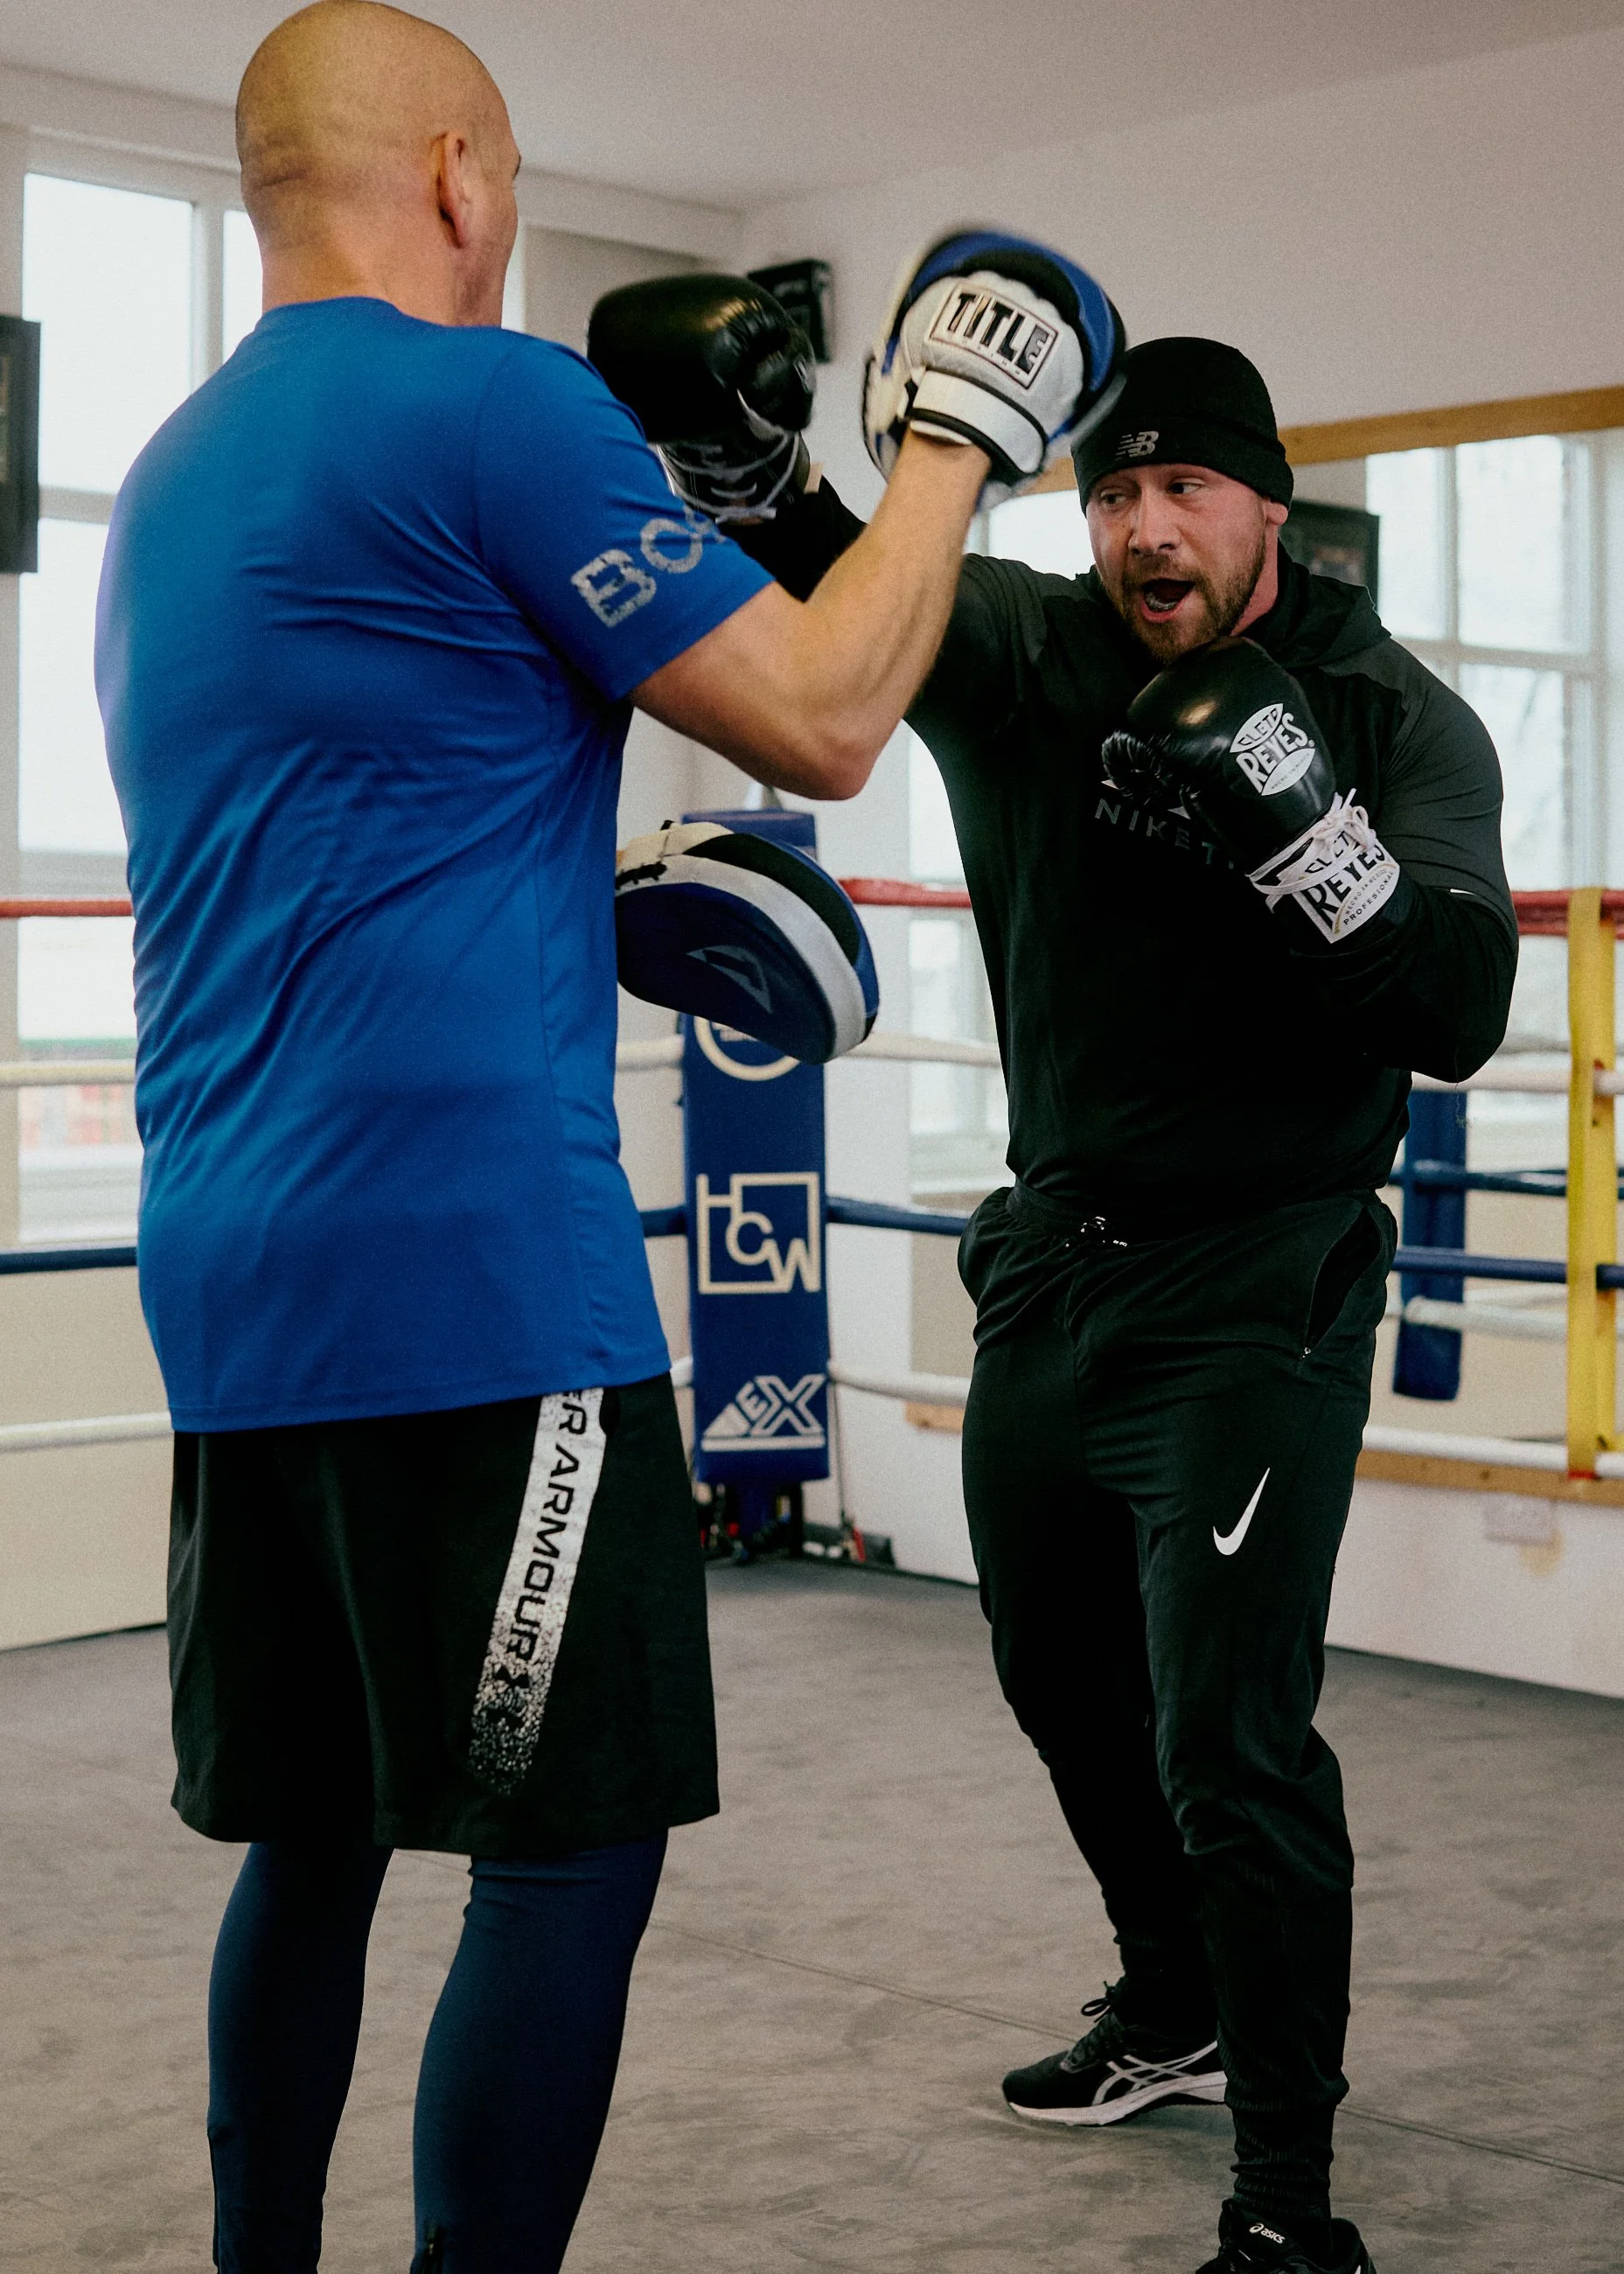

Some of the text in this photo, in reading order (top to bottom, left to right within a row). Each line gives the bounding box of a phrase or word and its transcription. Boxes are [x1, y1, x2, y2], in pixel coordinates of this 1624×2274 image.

[948, 293, 1049, 375] TITLE
[1342, 871, 1394, 926] PROFESIONAL
[506, 1441, 580, 1662] ARMOUR
[1260, 2226, 1286, 2244] asics
